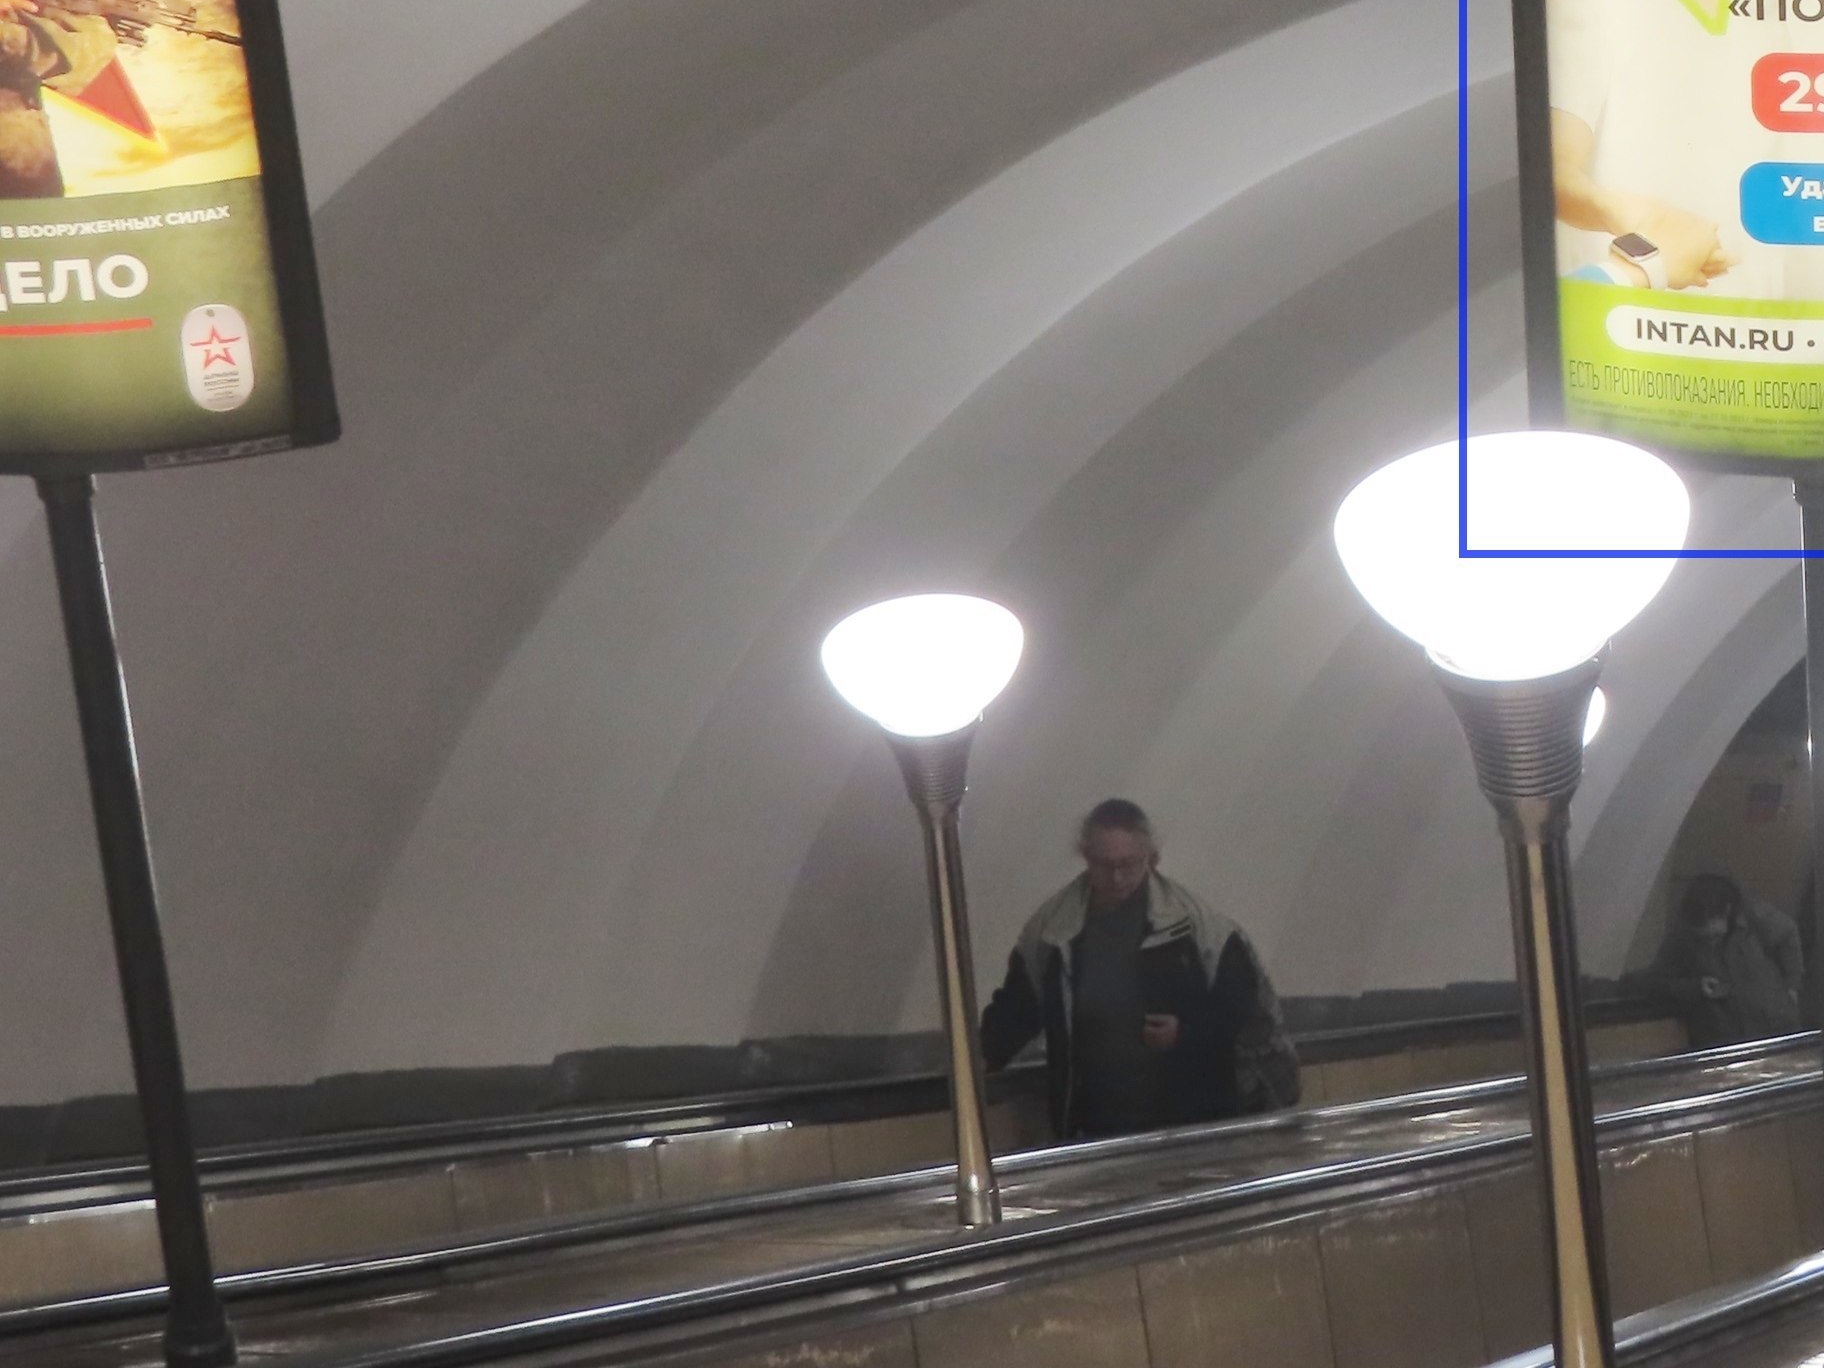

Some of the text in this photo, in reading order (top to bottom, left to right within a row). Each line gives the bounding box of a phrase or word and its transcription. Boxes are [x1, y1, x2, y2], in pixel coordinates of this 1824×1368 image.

[16, 213, 163, 239] ВООРУЖЕННЫХ
[167, 205, 231, 226] СИЛАХ
[0, 254, 149, 312] ЕЛО
[1635, 317, 1795, 352] INTAN.RU
[1569, 360, 1600, 391] ЕСТЬ
[1603, 365, 1751, 408] ПРОТИВОПОКАЗАНИЯ.
